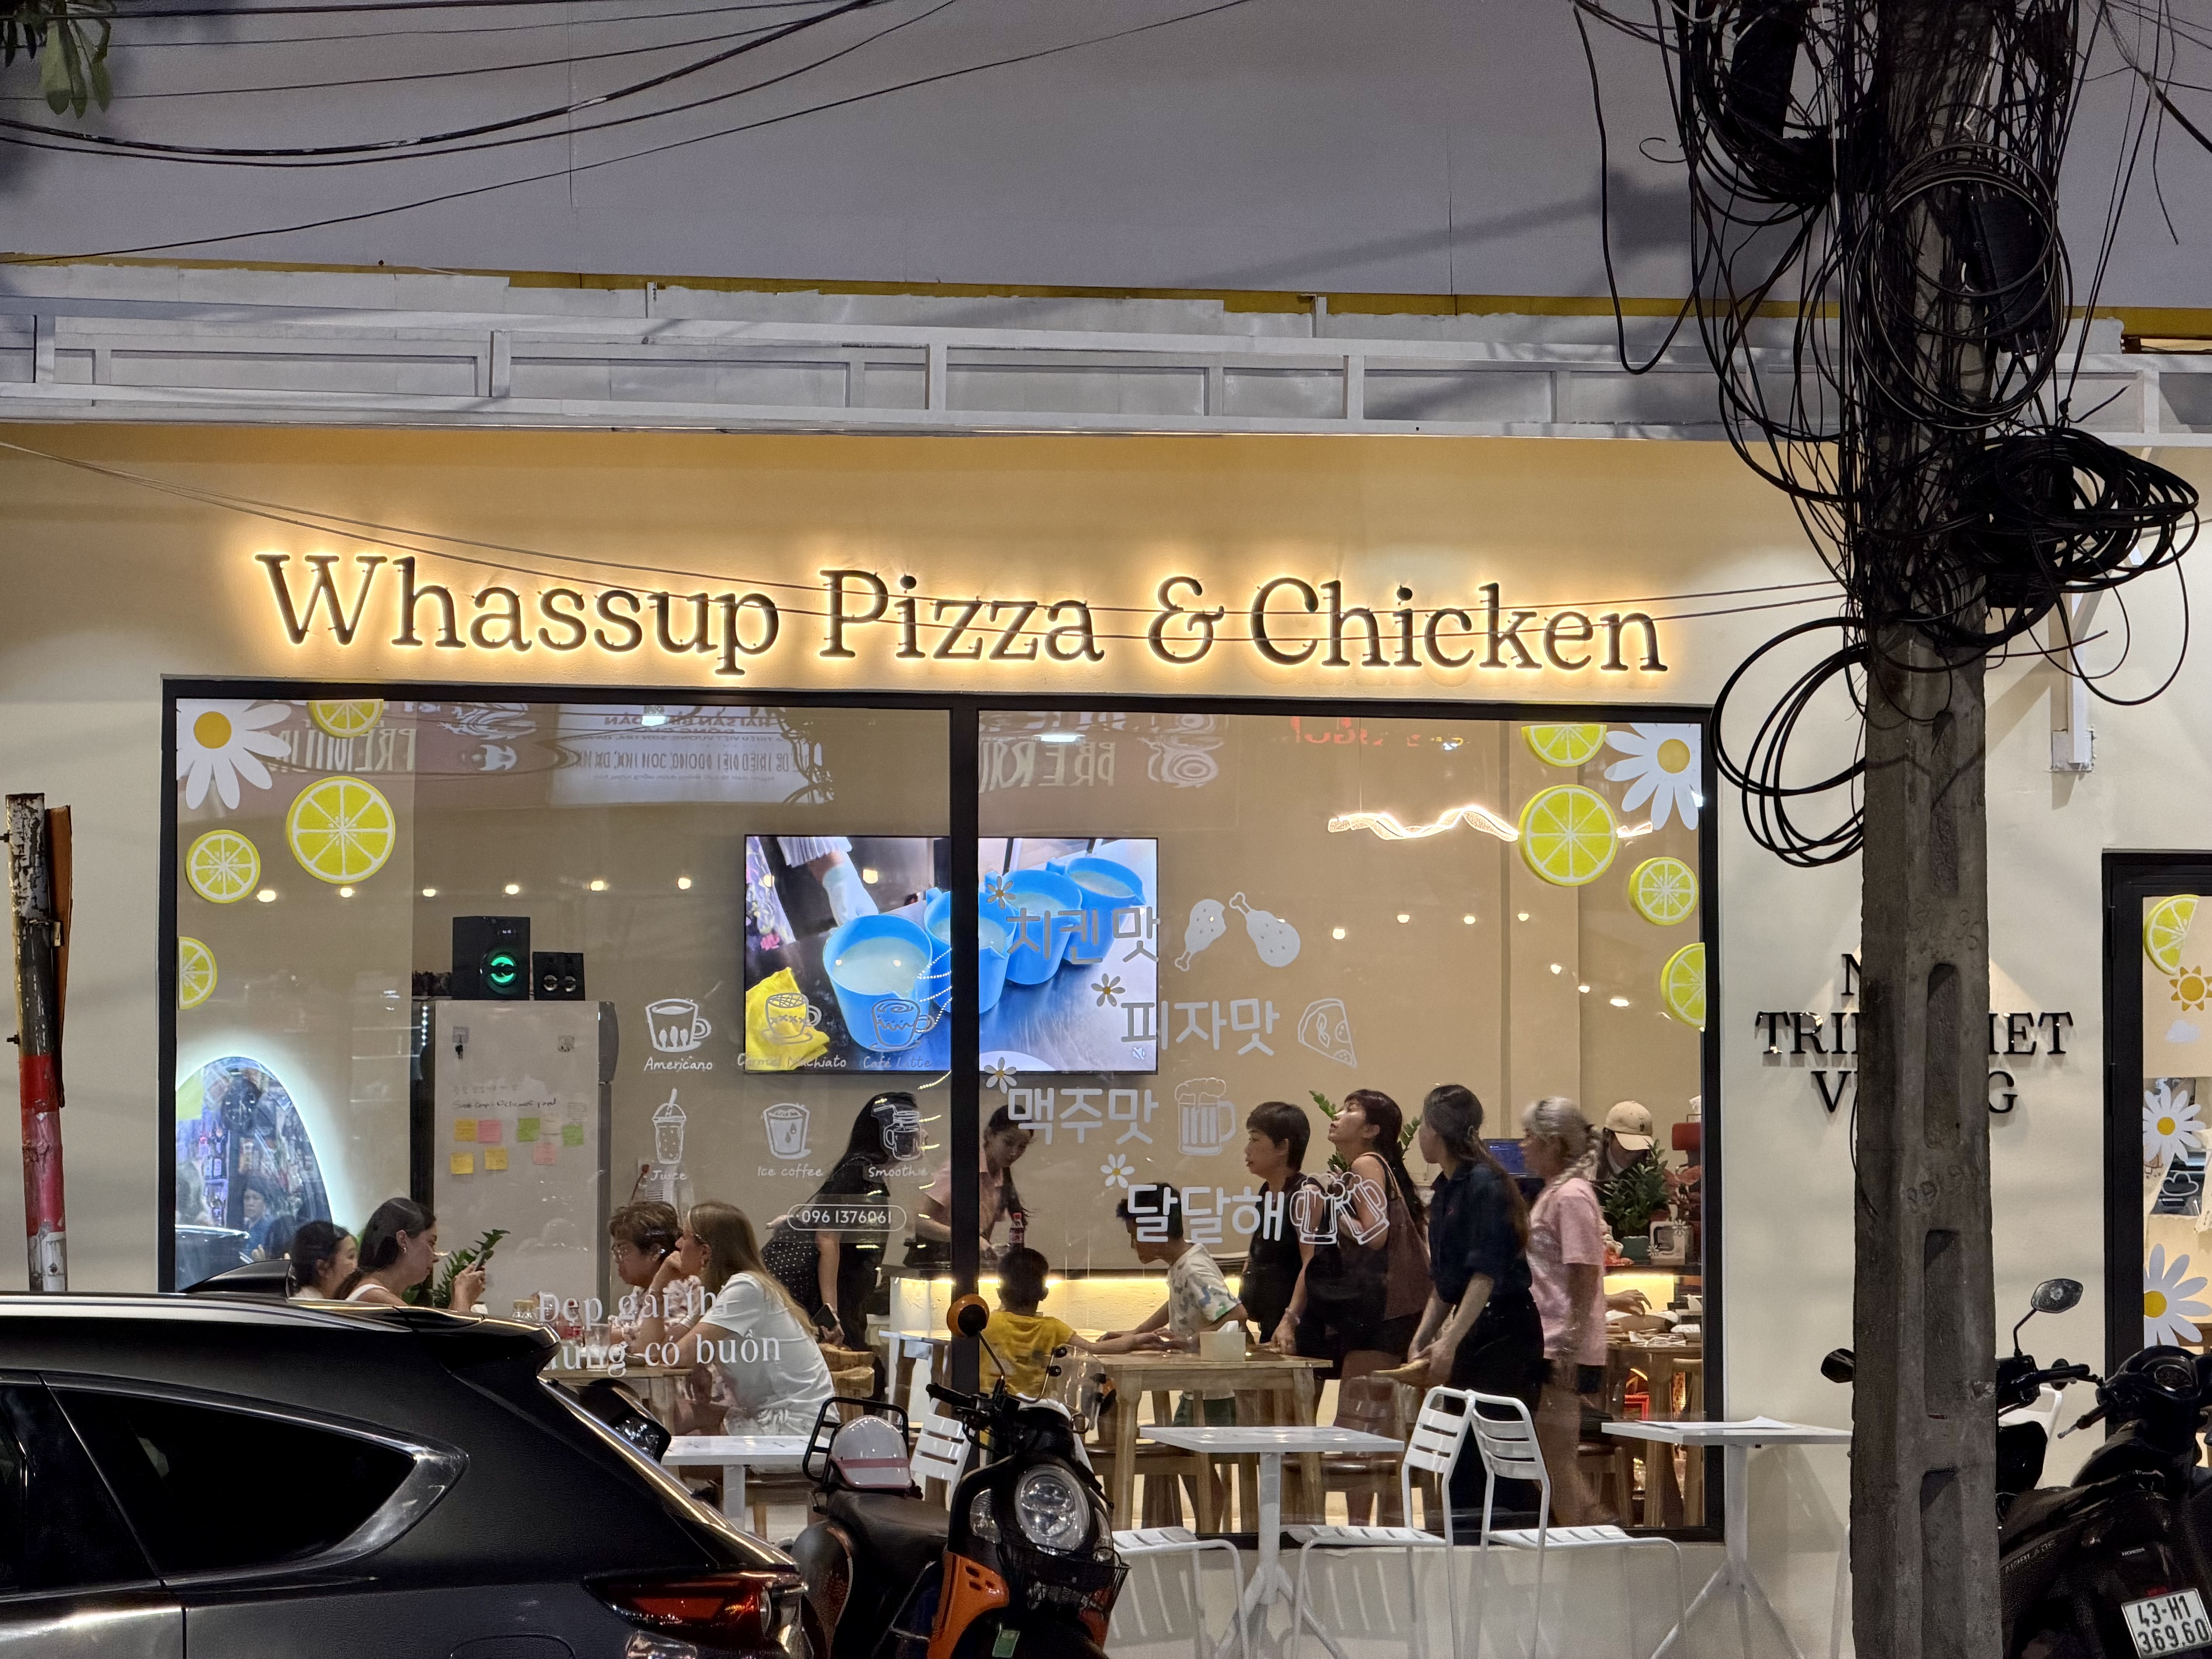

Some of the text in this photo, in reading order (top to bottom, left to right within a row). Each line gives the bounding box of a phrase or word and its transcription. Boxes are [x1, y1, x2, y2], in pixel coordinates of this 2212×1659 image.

[255, 554, 1668, 675] Whassup Pizza & Chicken
[1006, 906, 1161, 965] 치킨맛
[1121, 998, 1280, 1056] 피자맛
[643, 1056, 713, 1073] Americano
[1007, 1087, 1159, 1145] 맥주맛
[757, 1163, 824, 1179] Ice coffee
[868, 1164, 928, 1178] Smoothie
[802, 1210, 891, 1224] 096 1376061
[1127, 1183, 1285, 1244] 달달해
[2137, 1595, 2191, 1627] 43-H1
[2138, 1618, 2209, 1653] 369.60
